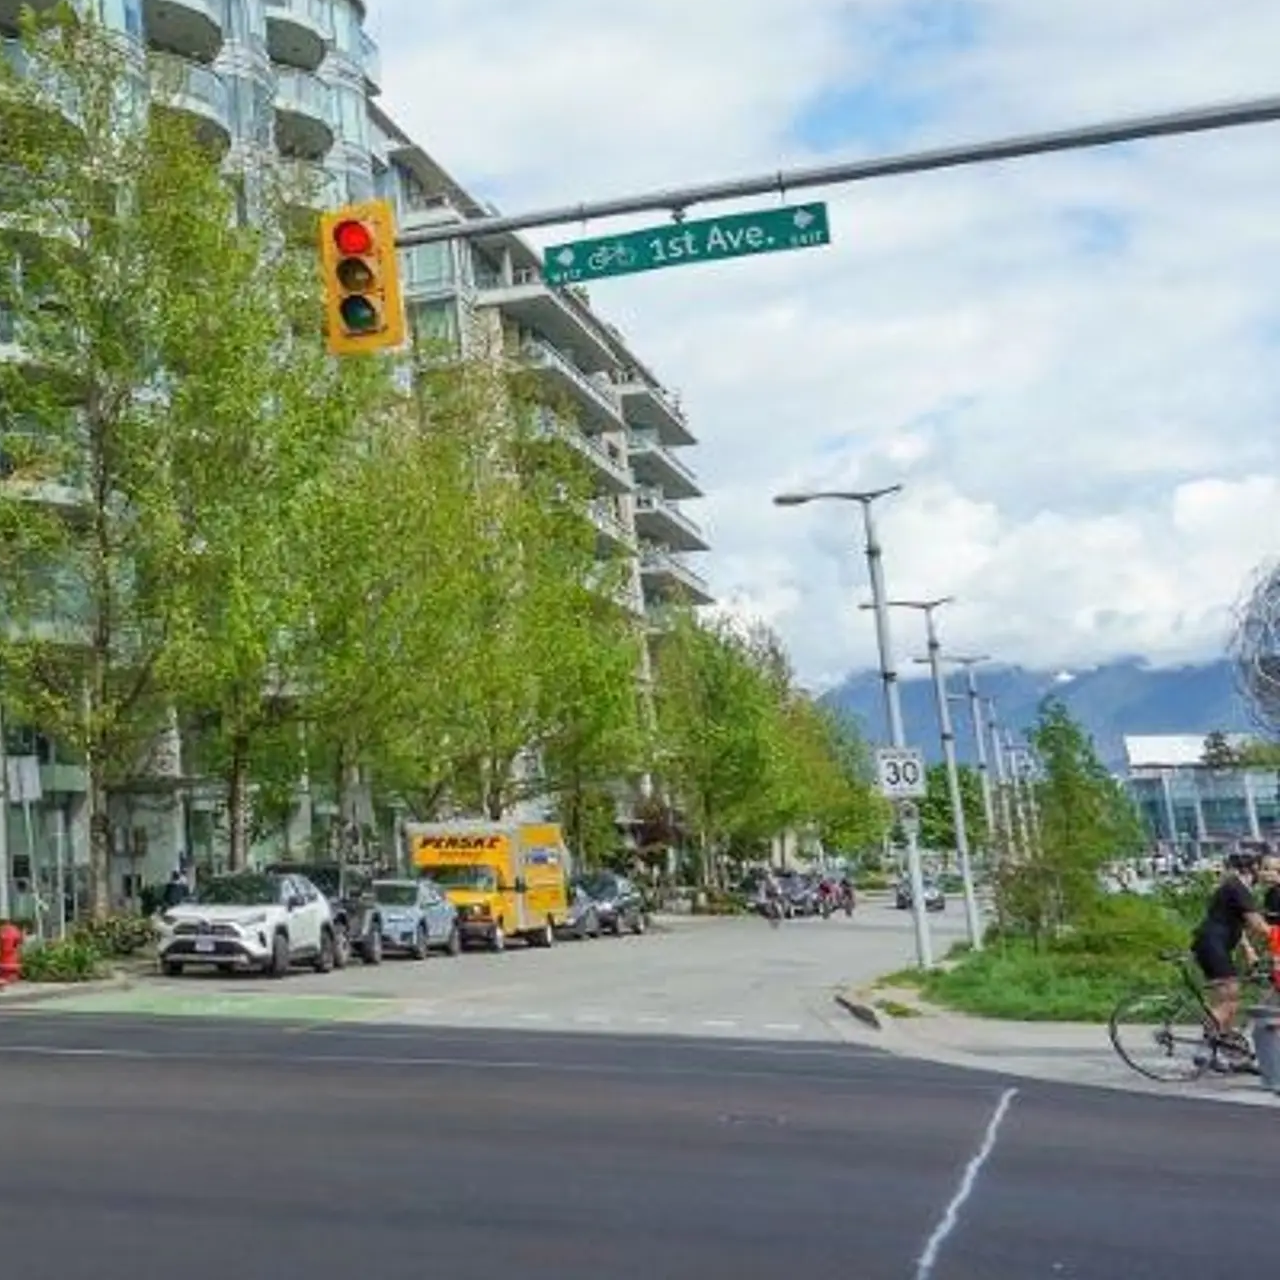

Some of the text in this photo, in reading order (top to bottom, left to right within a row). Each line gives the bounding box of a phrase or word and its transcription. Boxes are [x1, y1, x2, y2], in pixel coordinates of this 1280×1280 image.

[648, 223, 775, 261] 1st Ave.
[886, 761, 919, 785] 30
